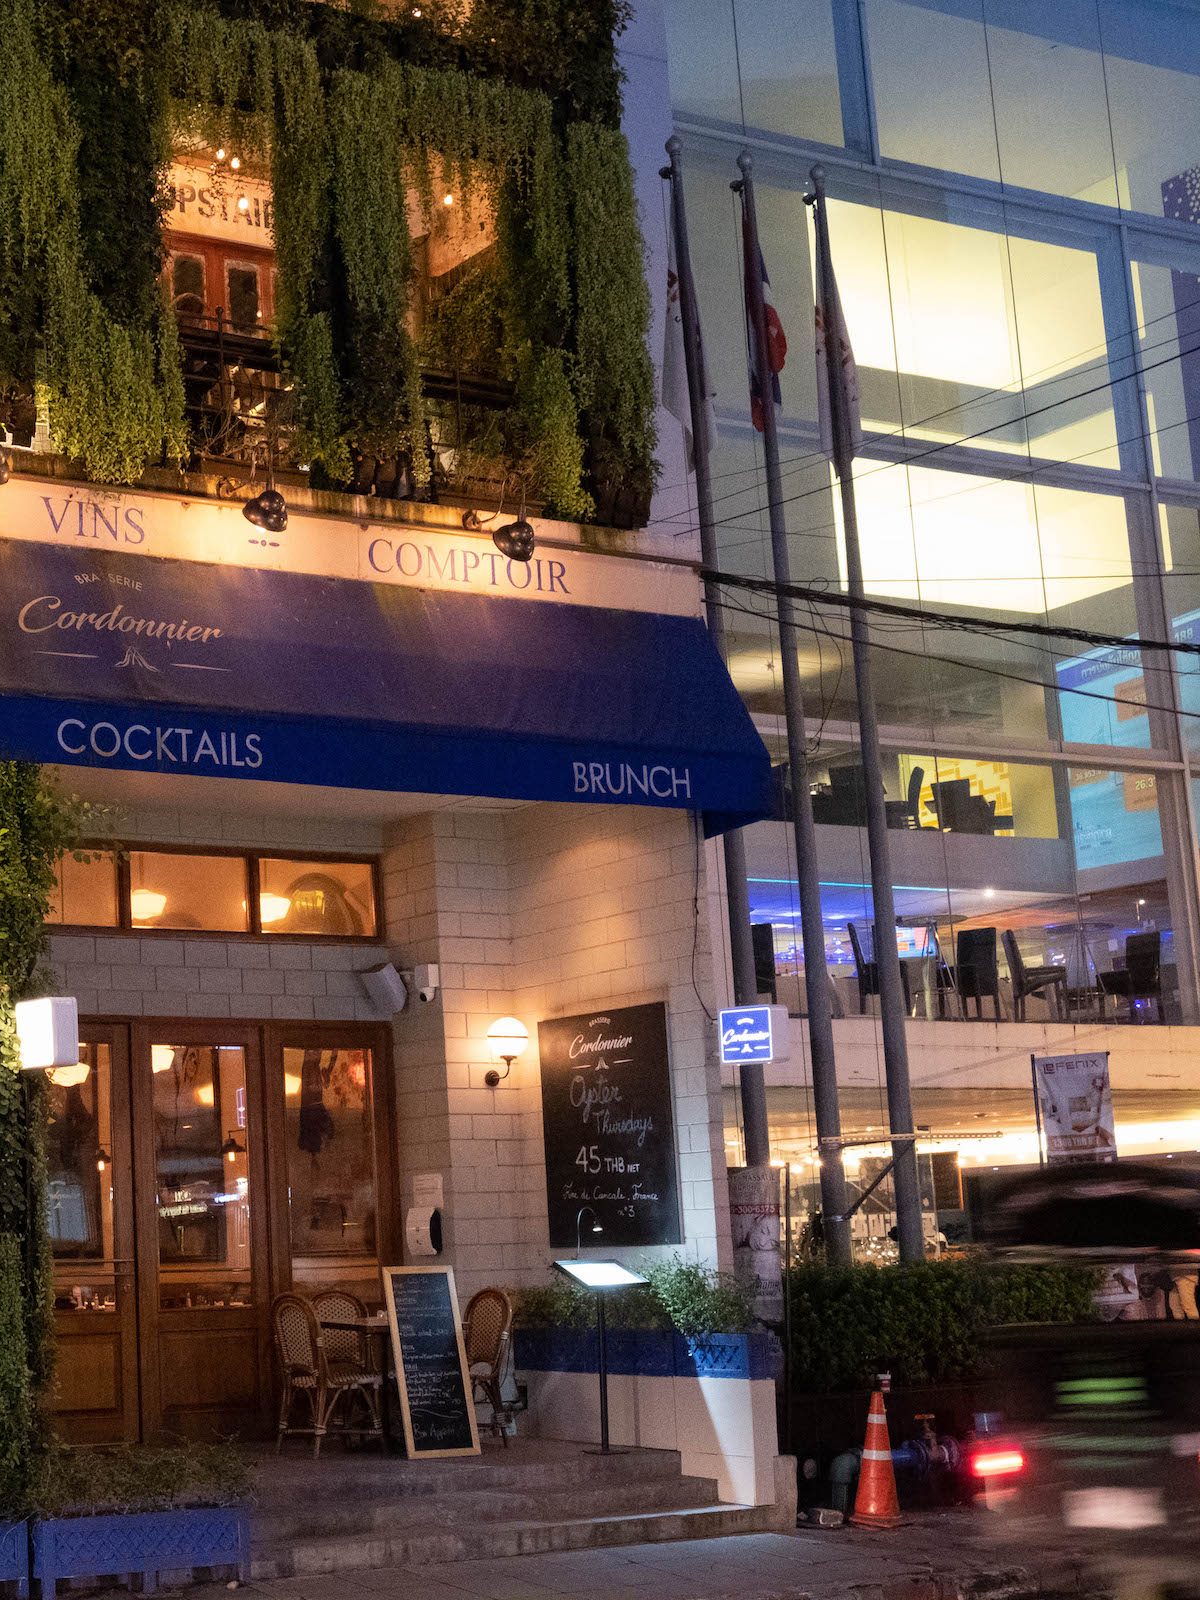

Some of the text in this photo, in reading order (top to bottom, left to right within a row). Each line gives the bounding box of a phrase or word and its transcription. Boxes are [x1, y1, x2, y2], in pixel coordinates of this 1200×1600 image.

[40, 496, 145, 544] VINS
[368, 538, 572, 594] COMPTOIR
[17, 594, 224, 646] Cordonnier
[57, 718, 263, 768] COCKTAILS
[572, 761, 691, 799] BRUNCH
[569, 1033, 633, 1060] Cordonnier
[575, 1145, 641, 1174] 45 THB NET
[632, 1183, 659, 1200] France
